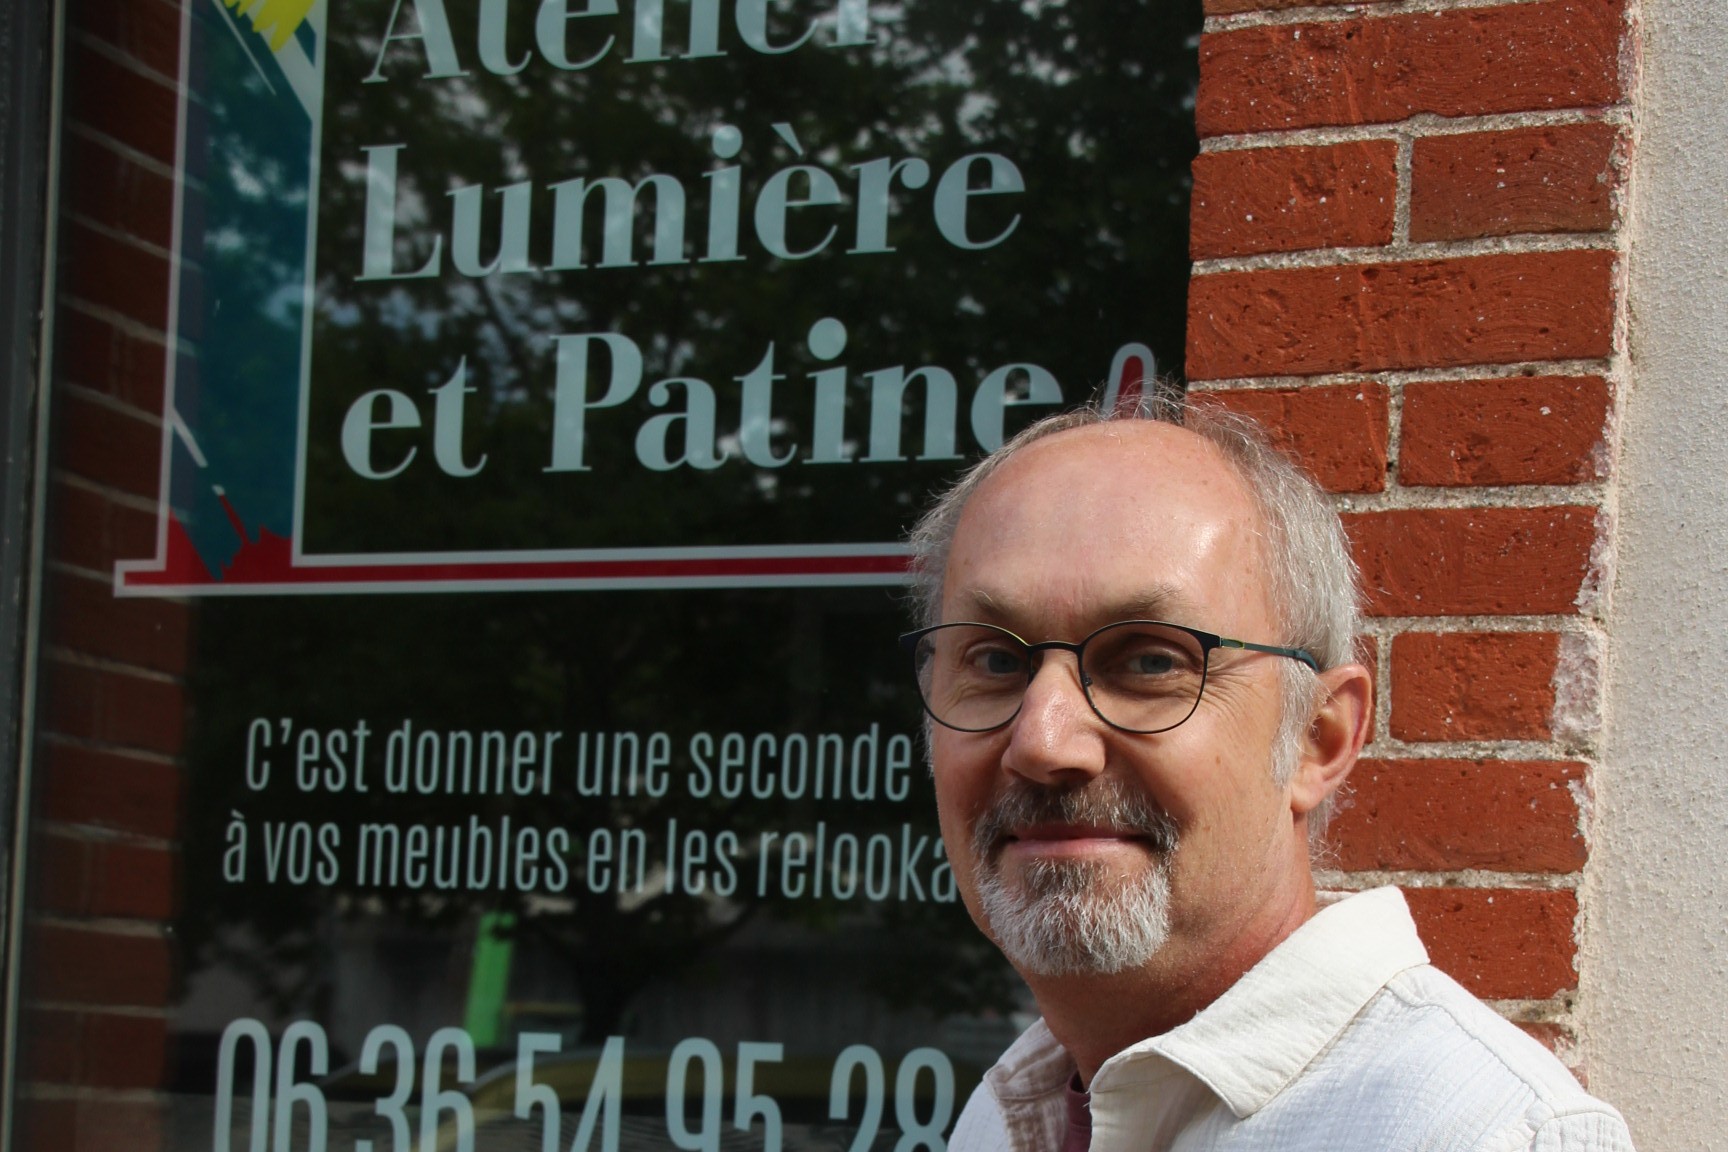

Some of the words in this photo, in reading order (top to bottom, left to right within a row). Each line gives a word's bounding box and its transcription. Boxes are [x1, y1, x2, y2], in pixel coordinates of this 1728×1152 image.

[354, 122, 1027, 282] Lumière
[340, 354, 488, 480] et
[541, 316, 1065, 474] Patine
[245, 717, 372, 793] C’est
[384, 719, 565, 797] donner
[576, 731, 671, 800] une
[689, 721, 912, 803] seconde
[222, 808, 248, 884] à
[263, 820, 340, 887] vos
[357, 815, 570, 893] meubles
[587, 826, 646, 894] en
[664, 818, 739, 897] les
[757, 820, 957, 903] relooka
